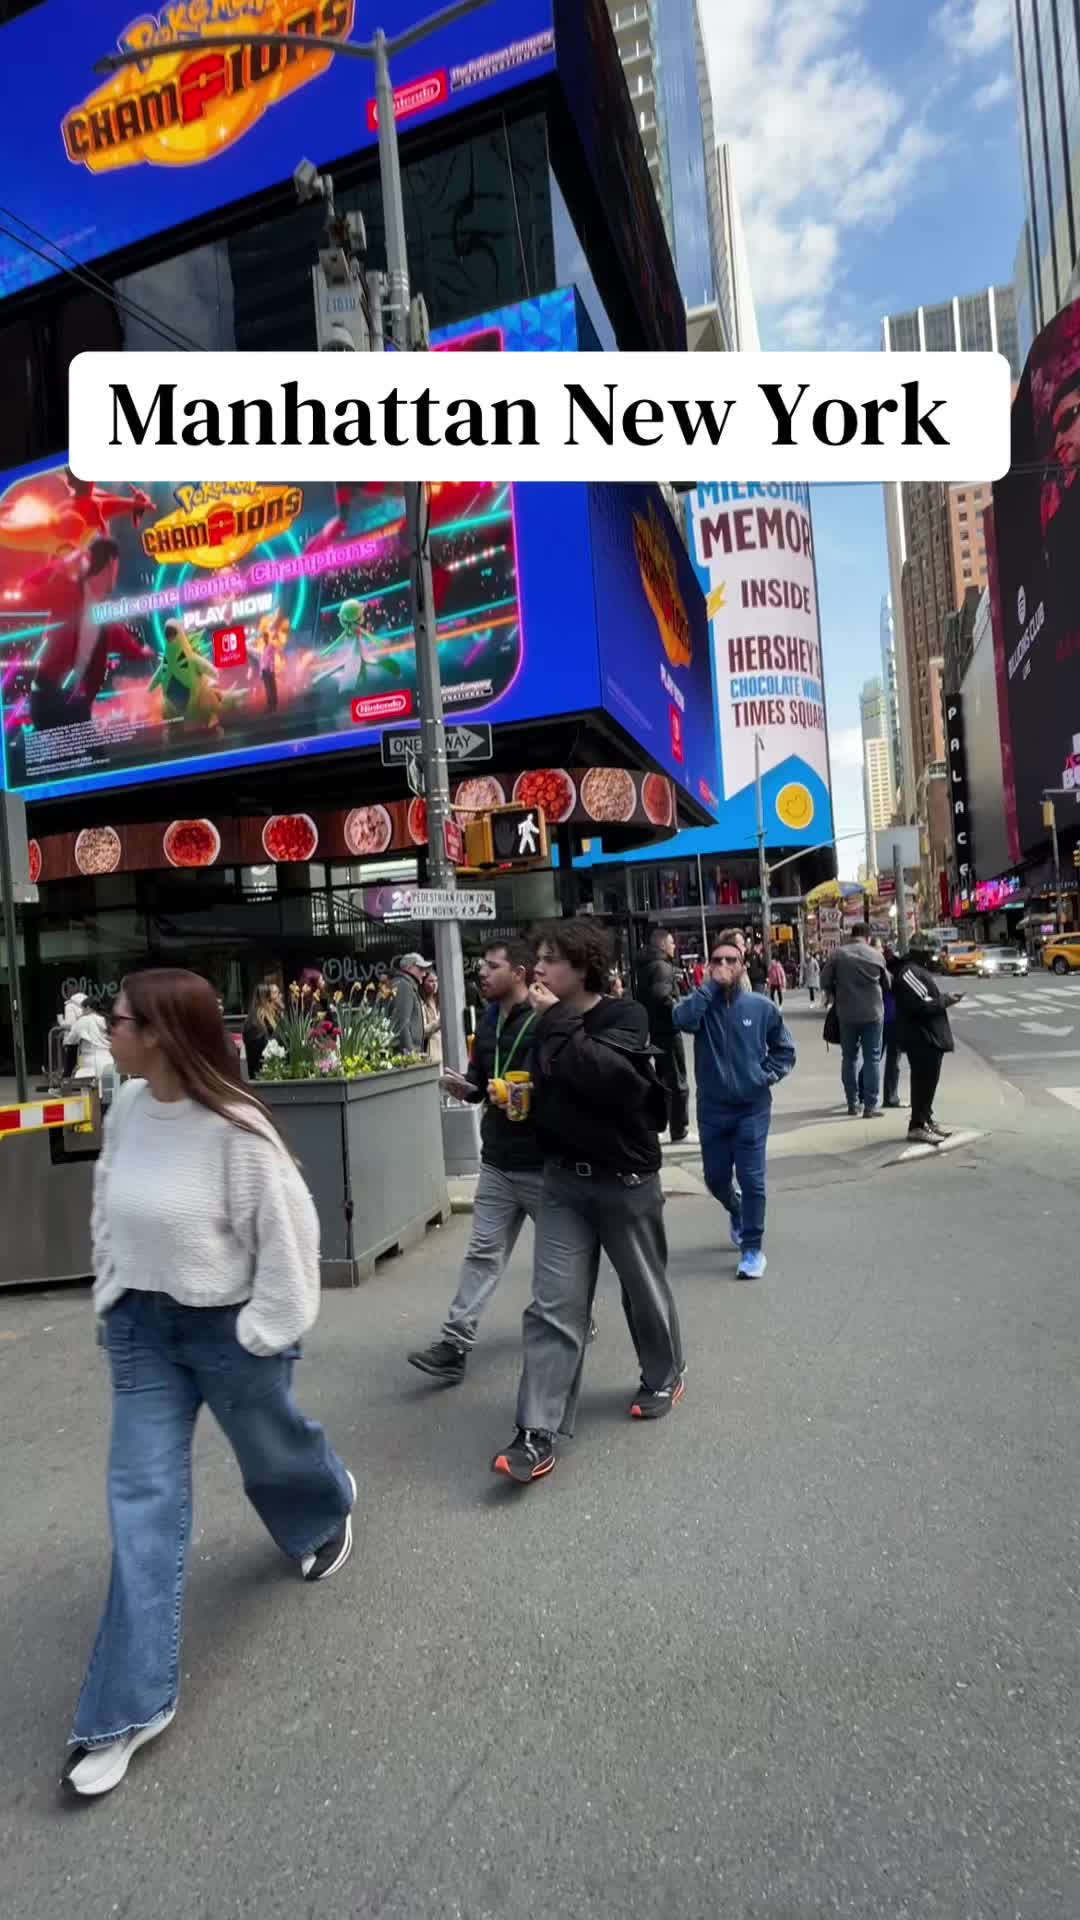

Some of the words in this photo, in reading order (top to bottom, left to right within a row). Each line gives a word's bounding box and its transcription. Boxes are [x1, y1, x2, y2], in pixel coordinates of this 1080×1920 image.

[66, 0, 352, 155] CHAMPIONS
[144, 488, 301, 552] CHAMPIONS
[700, 506, 813, 560] MEMOR
[91, 588, 180, 621] Welcome
[252, 543, 377, 581] Champions
[741, 578, 811, 614] INSIDE
[183, 605, 227, 629] PLAY
[232, 594, 273, 618] NOW
[730, 675, 800, 699] CHOCOLATE
[731, 699, 785, 728] TIMES
[394, 738, 422, 753] ONE
[948, 706, 970, 878] PALACE
[413, 905, 430, 916] KEEP
[323, 955, 387, 984] Olive
[62, 976, 118, 1000] Olive
